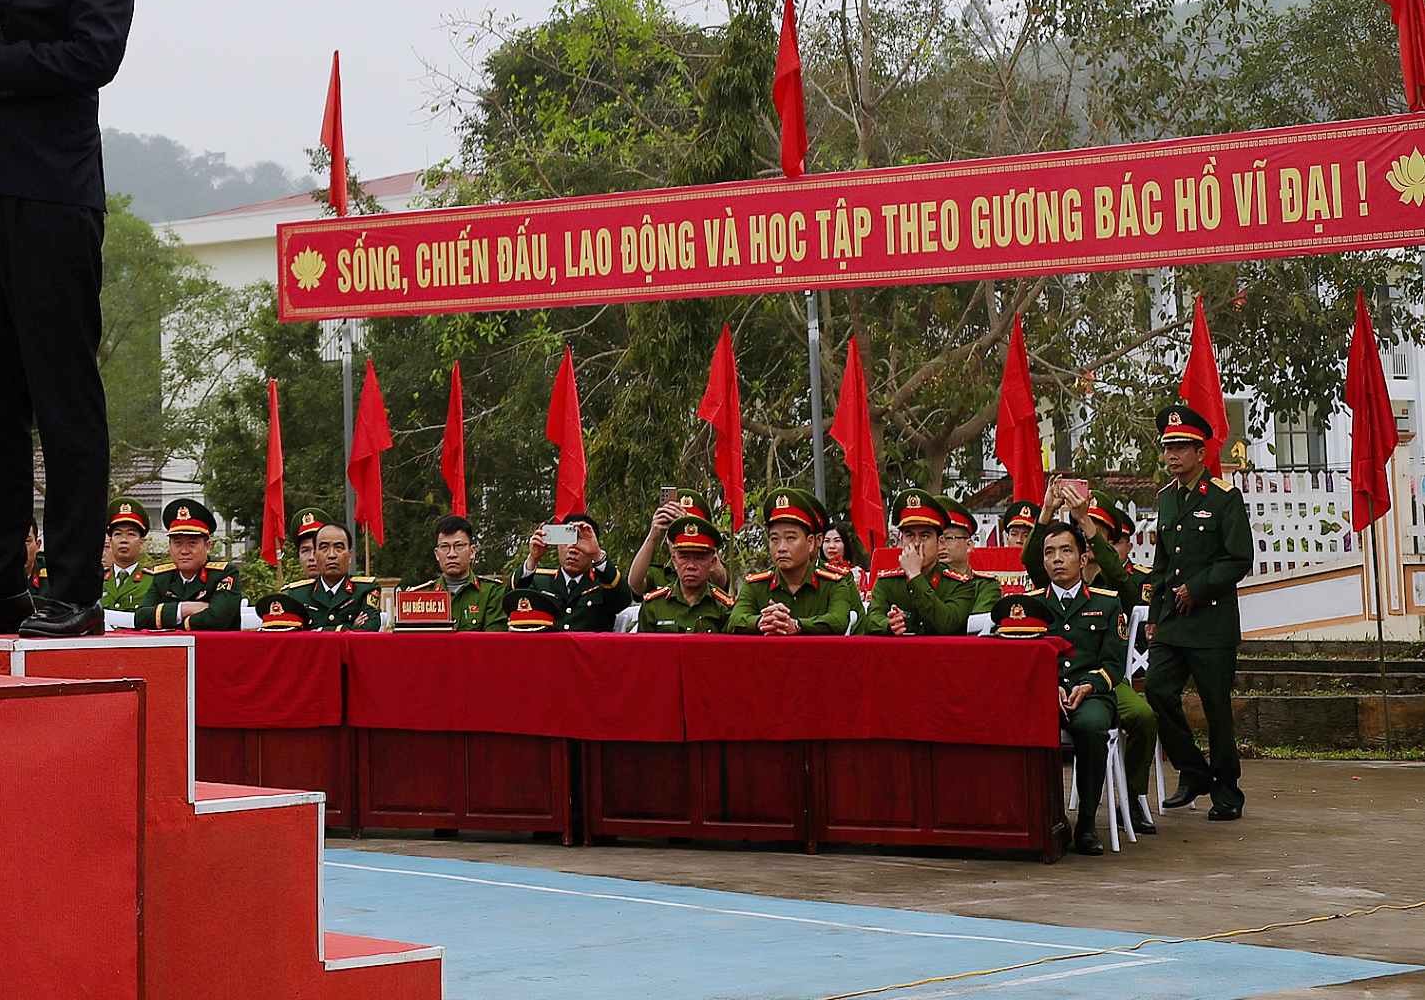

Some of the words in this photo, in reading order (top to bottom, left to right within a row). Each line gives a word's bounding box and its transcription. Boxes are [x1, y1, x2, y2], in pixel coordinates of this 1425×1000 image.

[337, 231, 408, 295] SỐNG,
[416, 224, 489, 288] CHIẾN
[496, 217, 556, 286] ĐẤU,
[565, 229, 612, 280] LAO
[621, 214, 693, 283] ĐỘNG
[703, 207, 740, 267] VÀ
[750, 211, 806, 274] HỌC
[816, 197, 872, 270] TẬP
[882, 199, 960, 256] THEO
[971, 187, 1082, 248] GƯƠNG
[1094, 171, 1163, 239] BÁC
[1175, 156, 1220, 232] HỒ
[1231, 159, 1268, 227] VĨ
[1280, 163, 1343, 233] ĐẠI
[1358, 160, 1369, 217] !
[437, 599, 446, 613] XÃ
